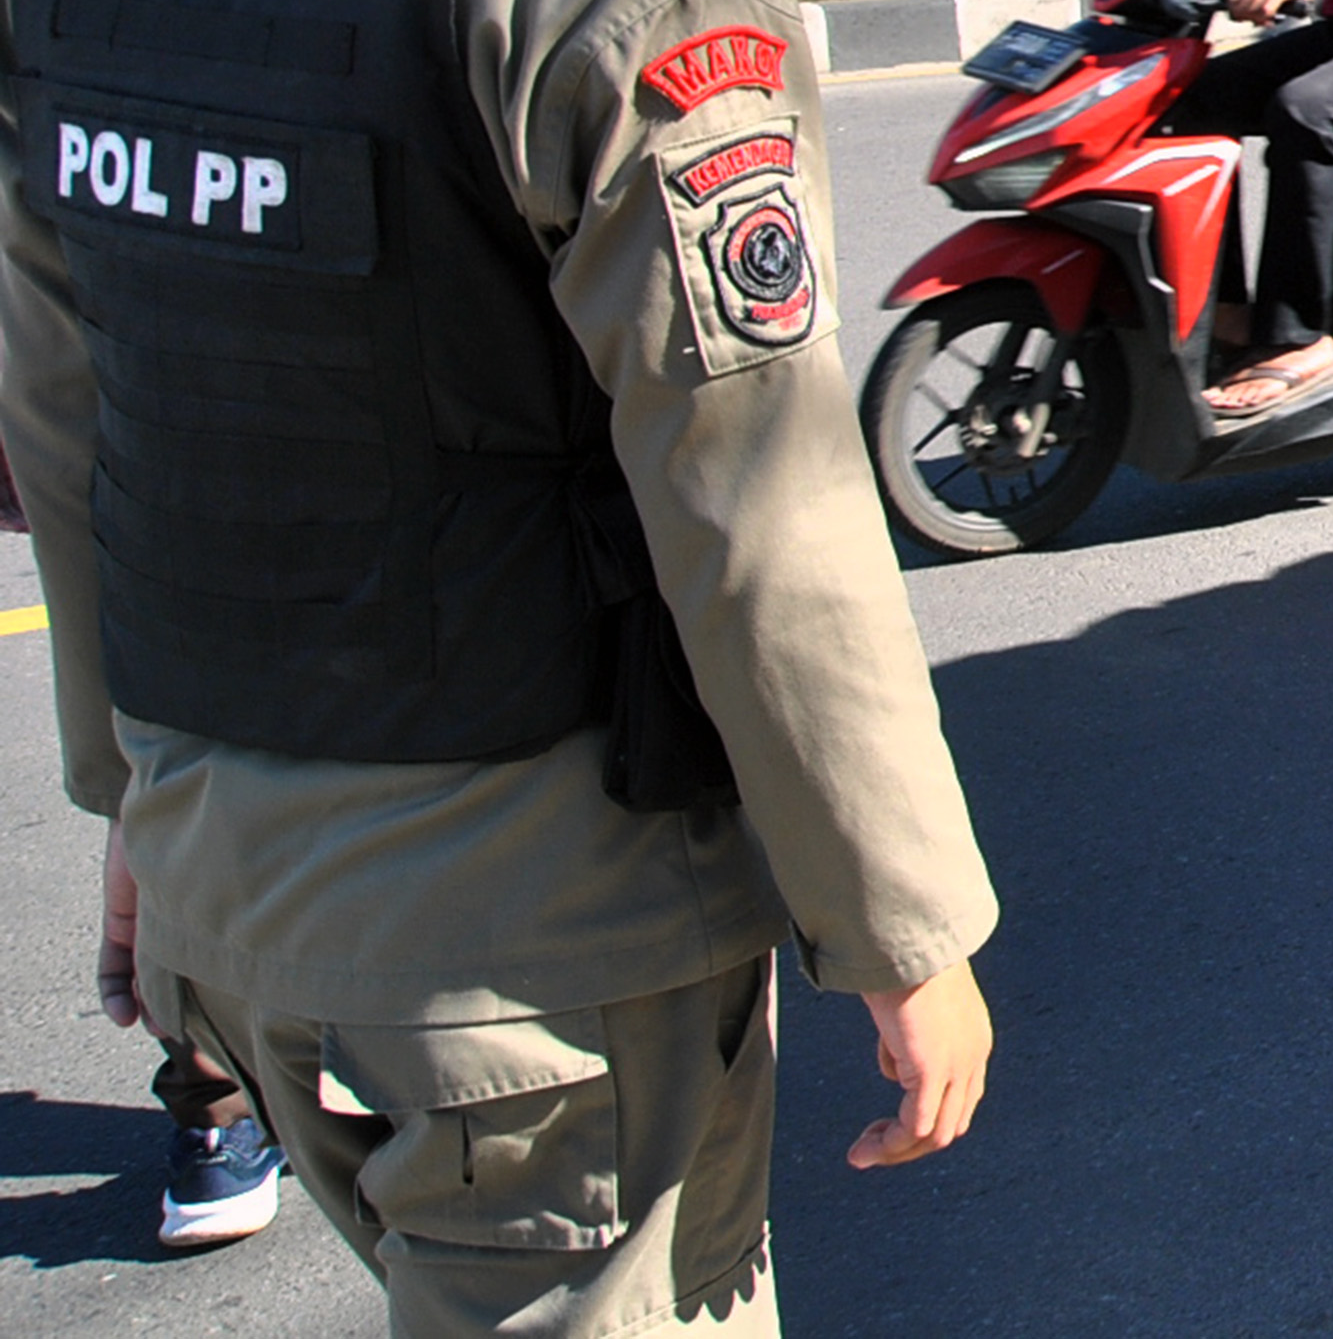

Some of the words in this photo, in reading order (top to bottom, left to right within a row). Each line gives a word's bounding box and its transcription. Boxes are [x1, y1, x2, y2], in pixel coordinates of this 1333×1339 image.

[664, 33, 776, 95] MAKO
[58, 122, 168, 218] POL
[191, 150, 288, 234] PP
